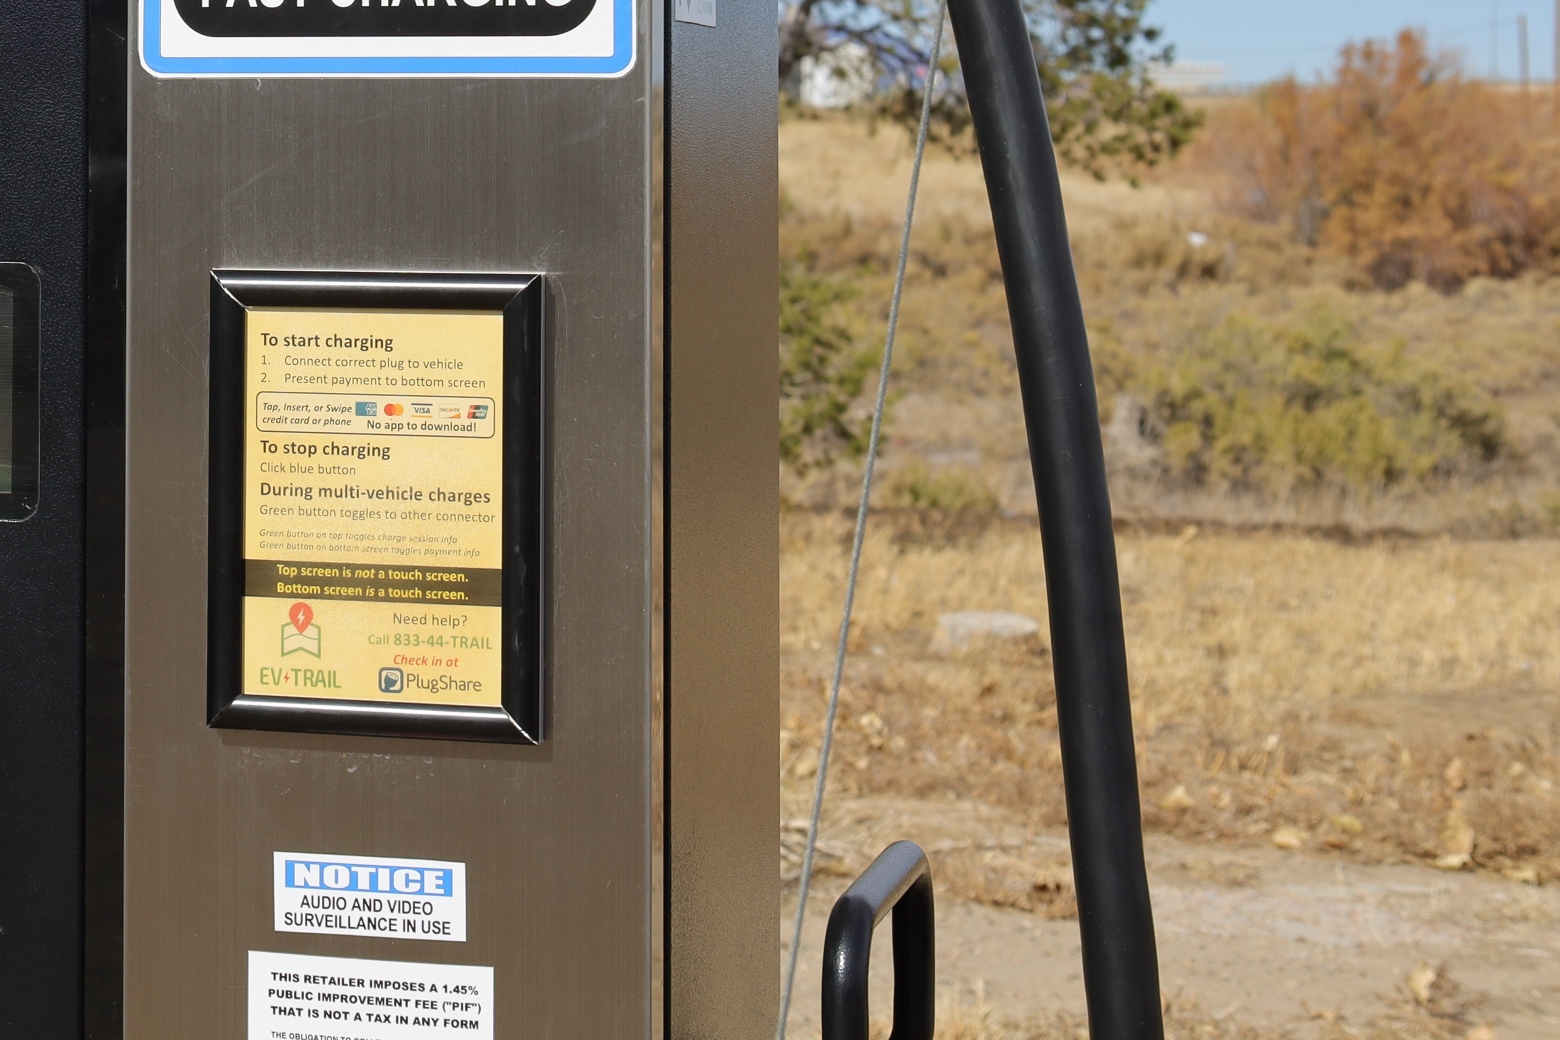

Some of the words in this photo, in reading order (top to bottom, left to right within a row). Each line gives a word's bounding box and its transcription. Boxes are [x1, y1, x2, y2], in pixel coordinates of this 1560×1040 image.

[260, 333, 278, 347] To
[283, 334, 320, 348] start
[325, 334, 393, 352] charging
[261, 356, 270, 366] 1.
[284, 356, 331, 367] Connect
[335, 358, 376, 368] correct
[380, 358, 404, 370] plug
[408, 359, 419, 369] to
[423, 359, 463, 370] vehicle
[260, 373, 270, 383] 2.
[284, 373, 327, 385] Present
[331, 375, 382, 388] payment
[386, 376, 397, 386] to
[401, 376, 444, 387] bottom
[447, 378, 485, 388] screen
[262, 403, 280, 413] Tap,
[283, 403, 312, 413] Insert,
[326, 404, 352, 415] Swipe
[262, 415, 287, 425] credit
[290, 416, 309, 426] card
[312, 418, 321, 426] or
[323, 417, 351, 428] phone
[367, 420, 381, 429] No
[385, 422, 404, 433] app
[407, 421, 417, 430] to
[420, 420, 477, 432] download!
[260, 440, 278, 454] To
[283, 442, 318, 457] stop
[322, 442, 390, 460] charging
[260, 462, 286, 473] Click
[290, 463, 314, 474] blue
[318, 464, 356, 475] button
[260, 482, 313, 500] During
[318, 484, 423, 501] multi-vehicle
[429, 489, 491, 505] charges
[276, 564, 297, 577] Top
[301, 566, 339, 577] screen
[342, 567, 351, 577] is
[355, 568, 375, 579] not
[378, 571, 385, 580] a
[388, 569, 422, 581] touch
[426, 572, 469, 582] screen.
[277, 582, 320, 594] Bottom
[324, 586, 362, 596] screen
[365, 586, 374, 596] is
[378, 588, 385, 597] a
[388, 587, 422, 599] touch
[426, 590, 469, 600] screen.
[393, 613, 427, 625] Need
[432, 614, 468, 629] help?
[368, 634, 389, 645] Call
[394, 634, 492, 650] 833-44-TRAIL
[393, 655, 428, 666] Check
[432, 656, 442, 667] in
[446, 658, 458, 668] at
[406, 673, 482, 693] PlugShare
[294, 863, 444, 894] NOTICE
[300, 895, 347, 910] AUDIO
[351, 898, 382, 912] AND
[387, 900, 433, 915] VIDEO
[284, 912, 398, 932] SURVEILLANCE
[403, 920, 416, 933] IN
[421, 921, 451, 935] USE
[271, 972, 299, 983] THIS
[304, 975, 365, 988] RETAILER
[369, 979, 425, 992] IMPOSES
[429, 984, 438, 993] A
[442, 984, 479, 995] 1.45%
[269, 989, 313, 1001] PUBLIC
[318, 992, 410, 1008] IMPROVEMENT
[415, 999, 438, 1010] FEE
[442, 1002, 481, 1014] ("PIF")
[271, 1006, 303, 1018] THAT
[308, 1009, 319, 1019] IS
[324, 1009, 350, 1021] NOT
[354, 1012, 362, 1021] A
[366, 1013, 391, 1024] TAX
[395, 1016, 409, 1025] IN
[413, 1017, 439, 1028] ANY
[444, 1018, 479, 1030] FORM
